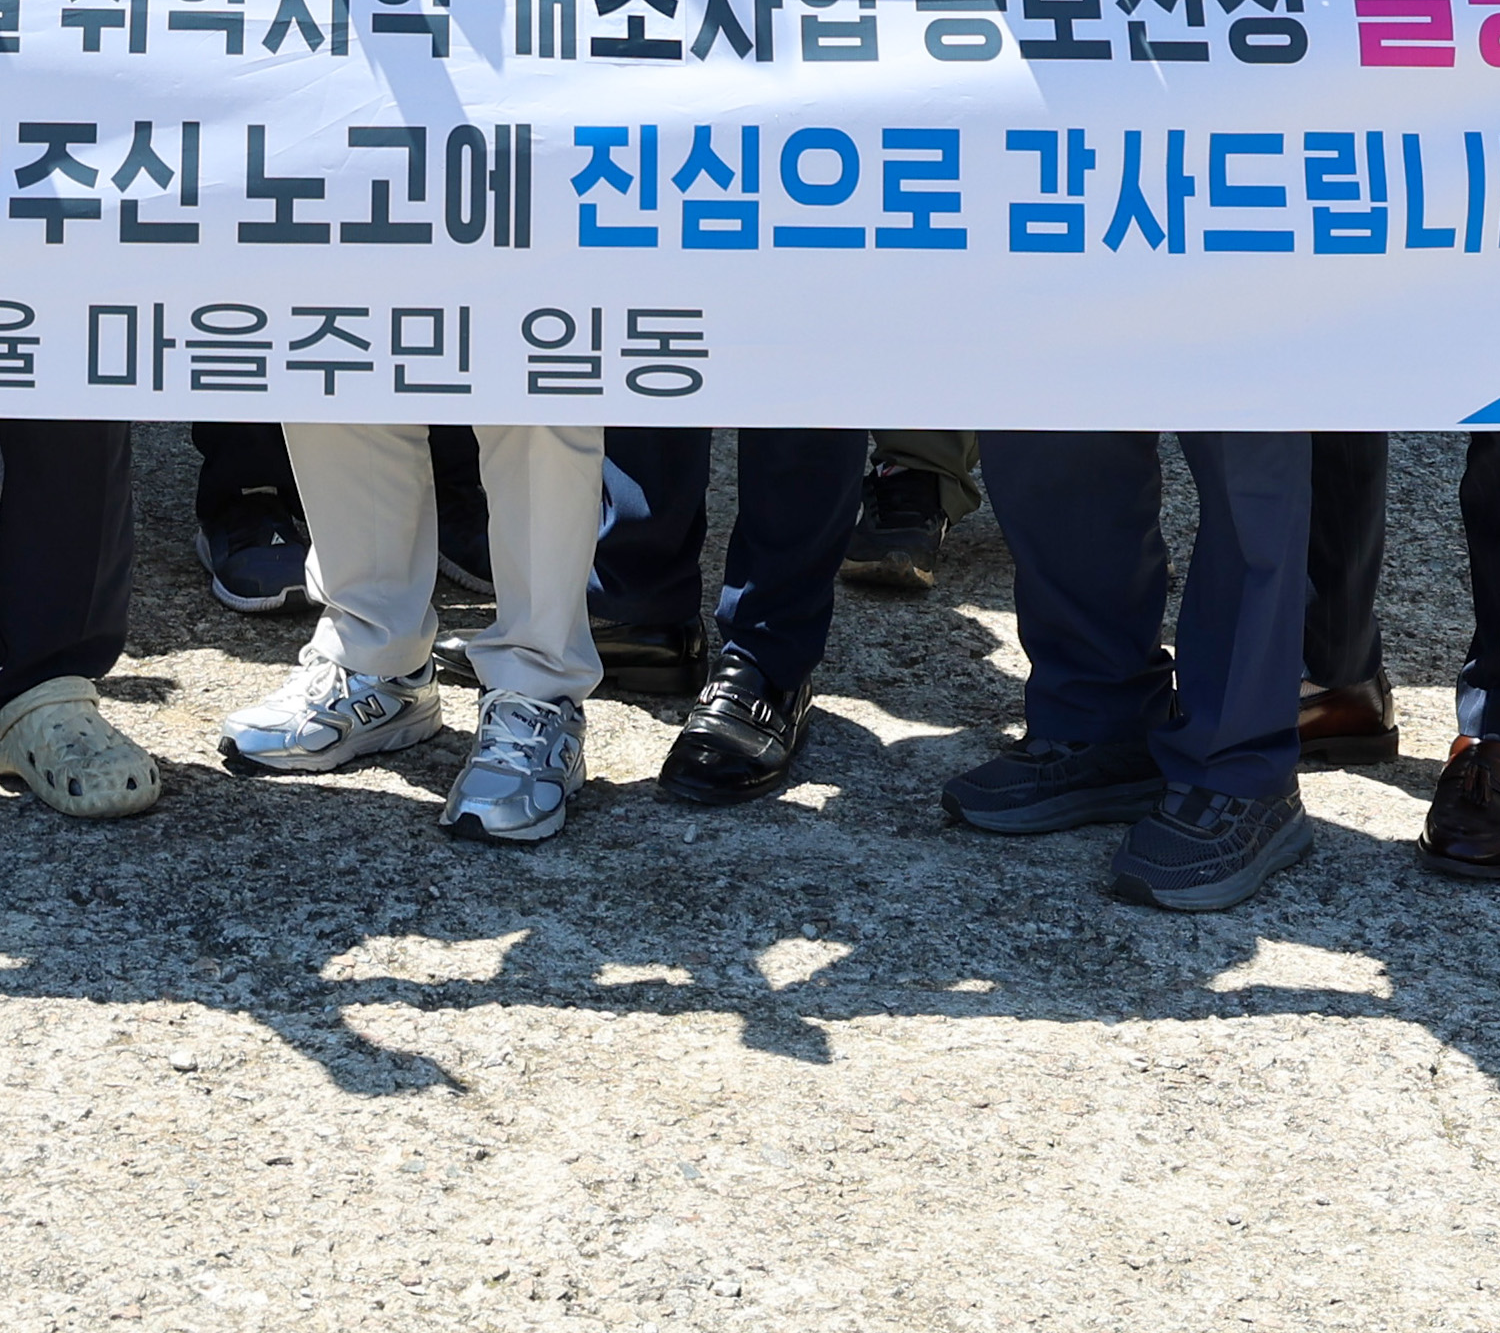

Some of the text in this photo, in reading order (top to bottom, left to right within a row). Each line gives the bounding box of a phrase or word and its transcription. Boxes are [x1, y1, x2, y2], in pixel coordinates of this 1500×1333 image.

[238, 124, 532, 249] 노고에
[570, 125, 967, 250] 진심으로
[88, 303, 471, 395] 마을주민
[521, 308, 709, 397] 일동
[352, 694, 386, 725] N
